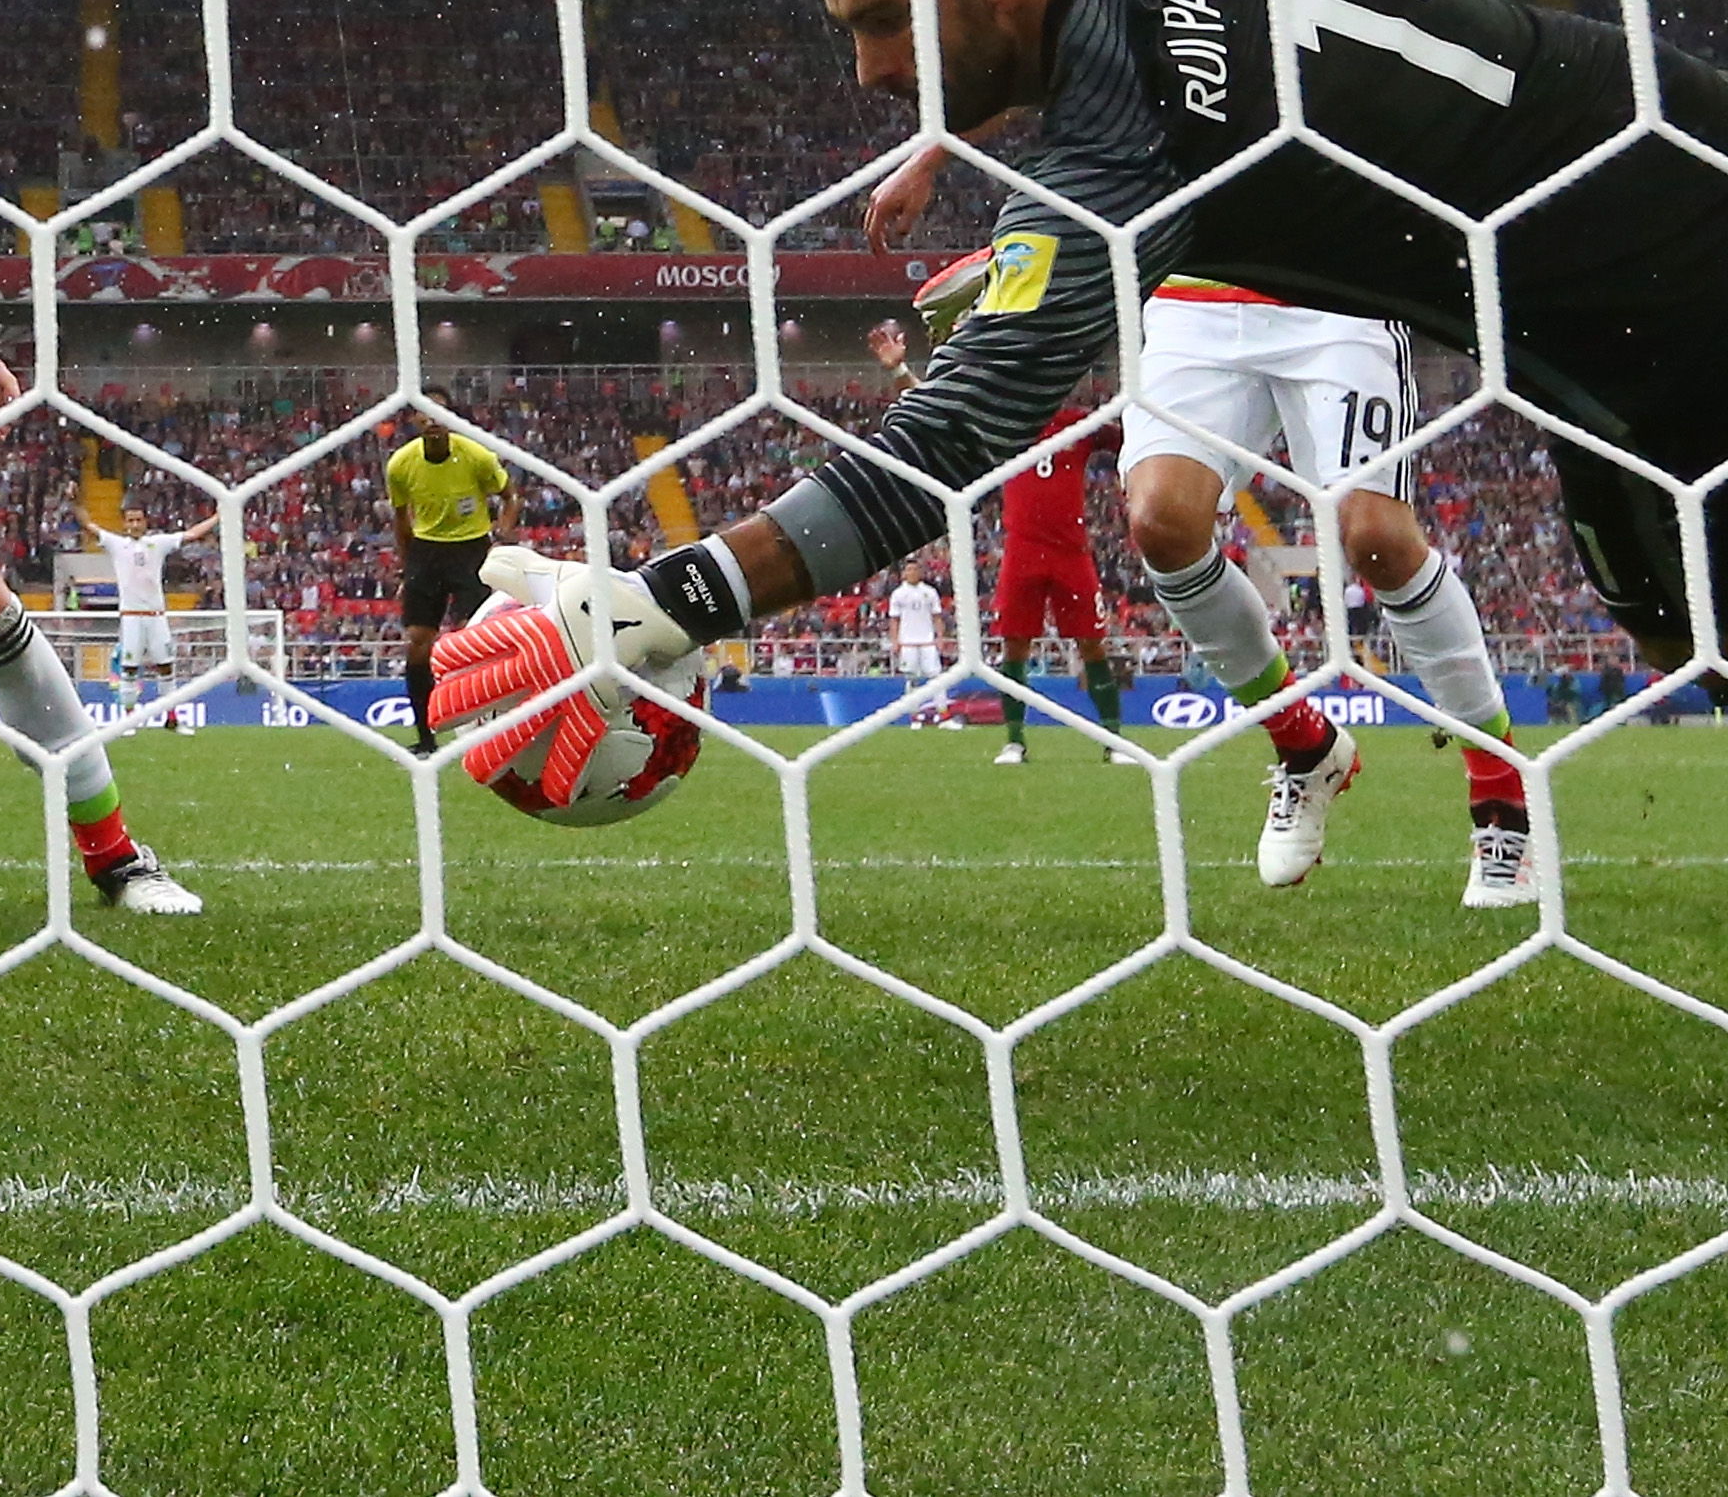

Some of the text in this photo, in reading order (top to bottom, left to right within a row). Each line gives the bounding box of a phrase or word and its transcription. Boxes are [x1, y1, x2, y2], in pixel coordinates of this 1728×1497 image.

[1166, 37, 1228, 123] RUI
[656, 264, 782, 288] MOSCO
[1338, 389, 1393, 469] 19
[681, 581, 699, 604] RUI
[1573, 519, 1621, 595] 1
